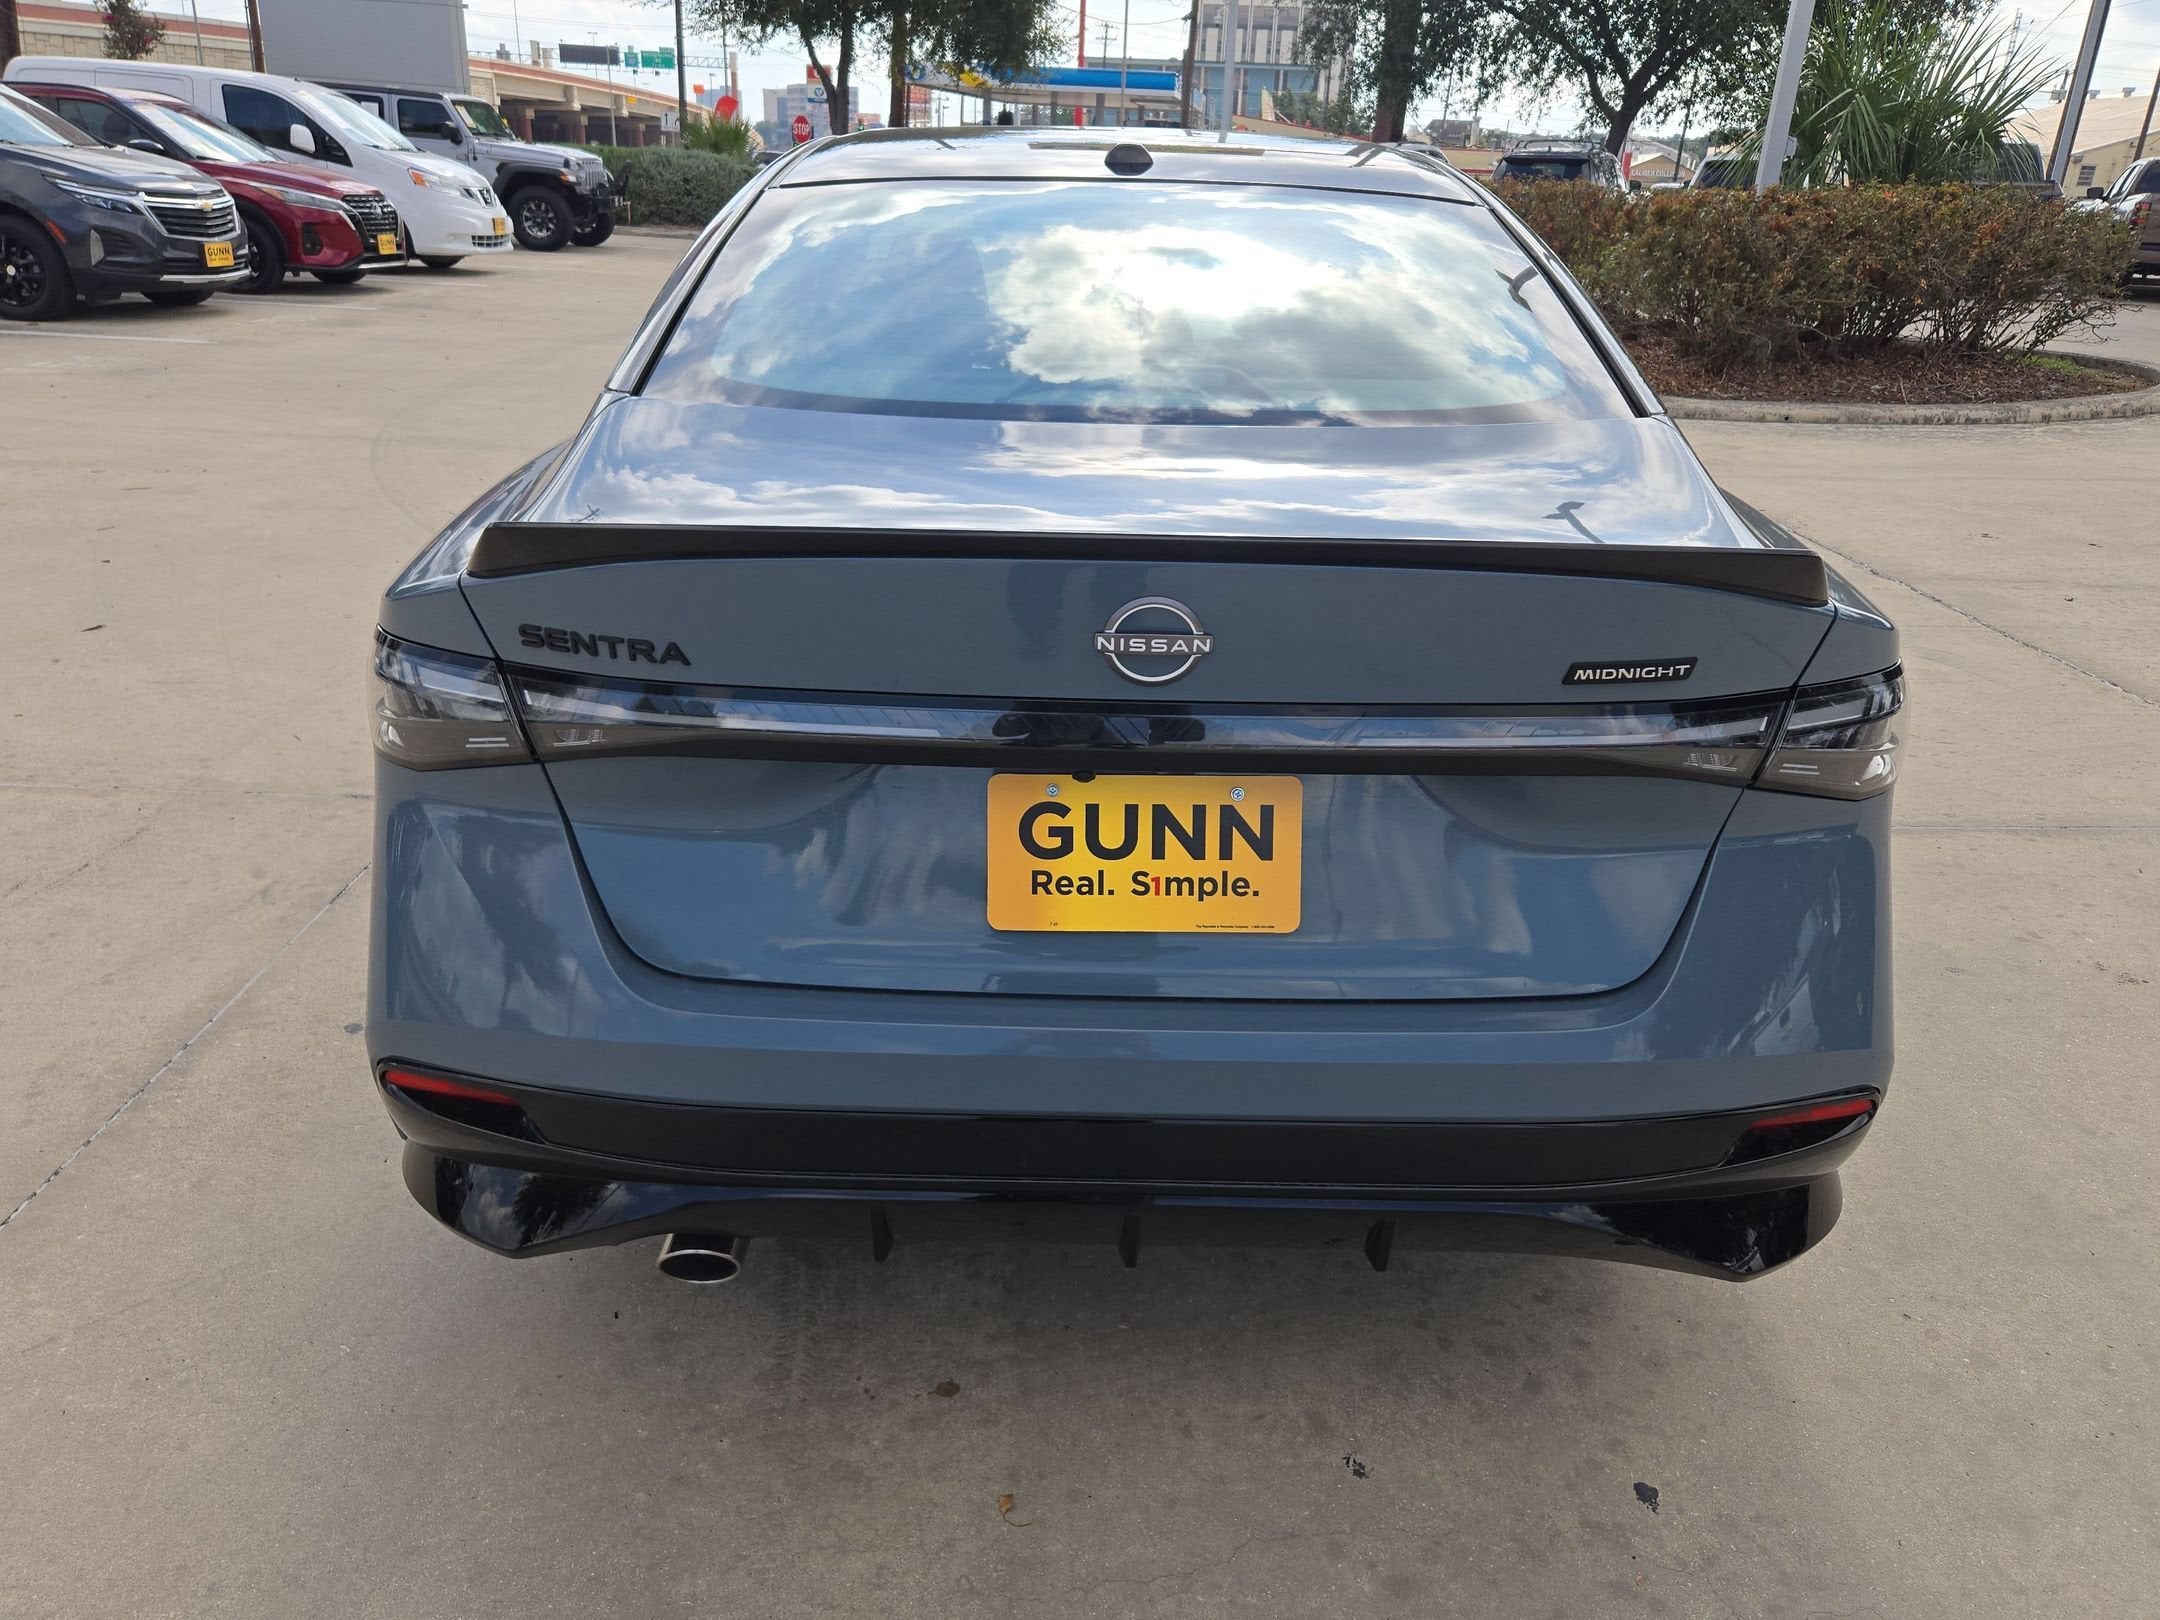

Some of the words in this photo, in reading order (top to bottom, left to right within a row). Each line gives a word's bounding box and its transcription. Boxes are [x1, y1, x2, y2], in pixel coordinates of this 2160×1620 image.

[793, 123, 811, 136] STOP
[207, 246, 230, 256] GUNN
[518, 623, 692, 666] SENTRA
[1097, 636, 1211, 653] NISSAN
[1574, 665, 1690, 681] MIDNIGHT
[1018, 801, 1275, 861] GUNN
[1031, 869, 1115, 896] Real.
[1130, 870, 1259, 902] S1mple.
